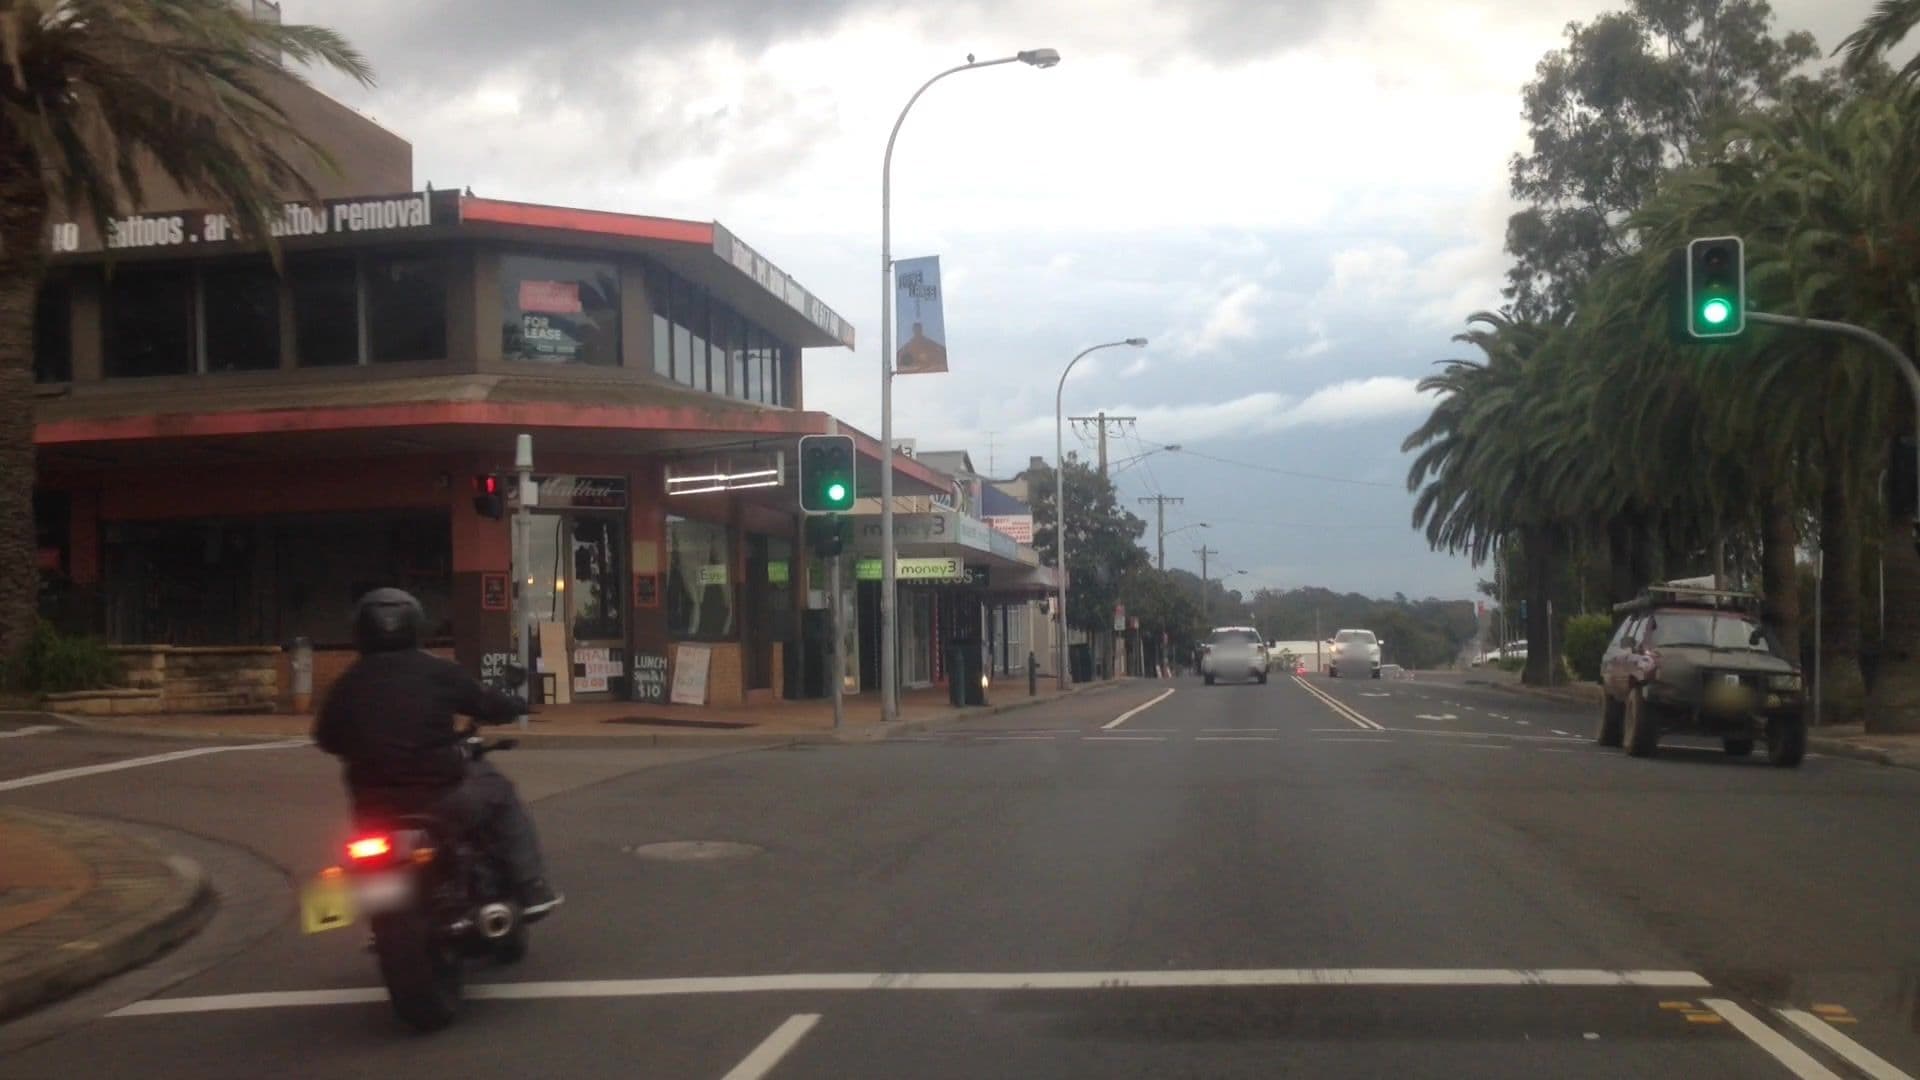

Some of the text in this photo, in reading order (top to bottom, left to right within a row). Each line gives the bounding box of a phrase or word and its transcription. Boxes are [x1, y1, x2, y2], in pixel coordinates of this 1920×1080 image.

[333, 191, 432, 233] removal
[524, 315, 549, 329] FOR
[524, 327, 561, 341] LEASE
[863, 515, 945, 538] mney3
[901, 560, 957, 575] money3
[634, 655, 668, 671] LUNCH
[638, 683, 661, 698] $10
